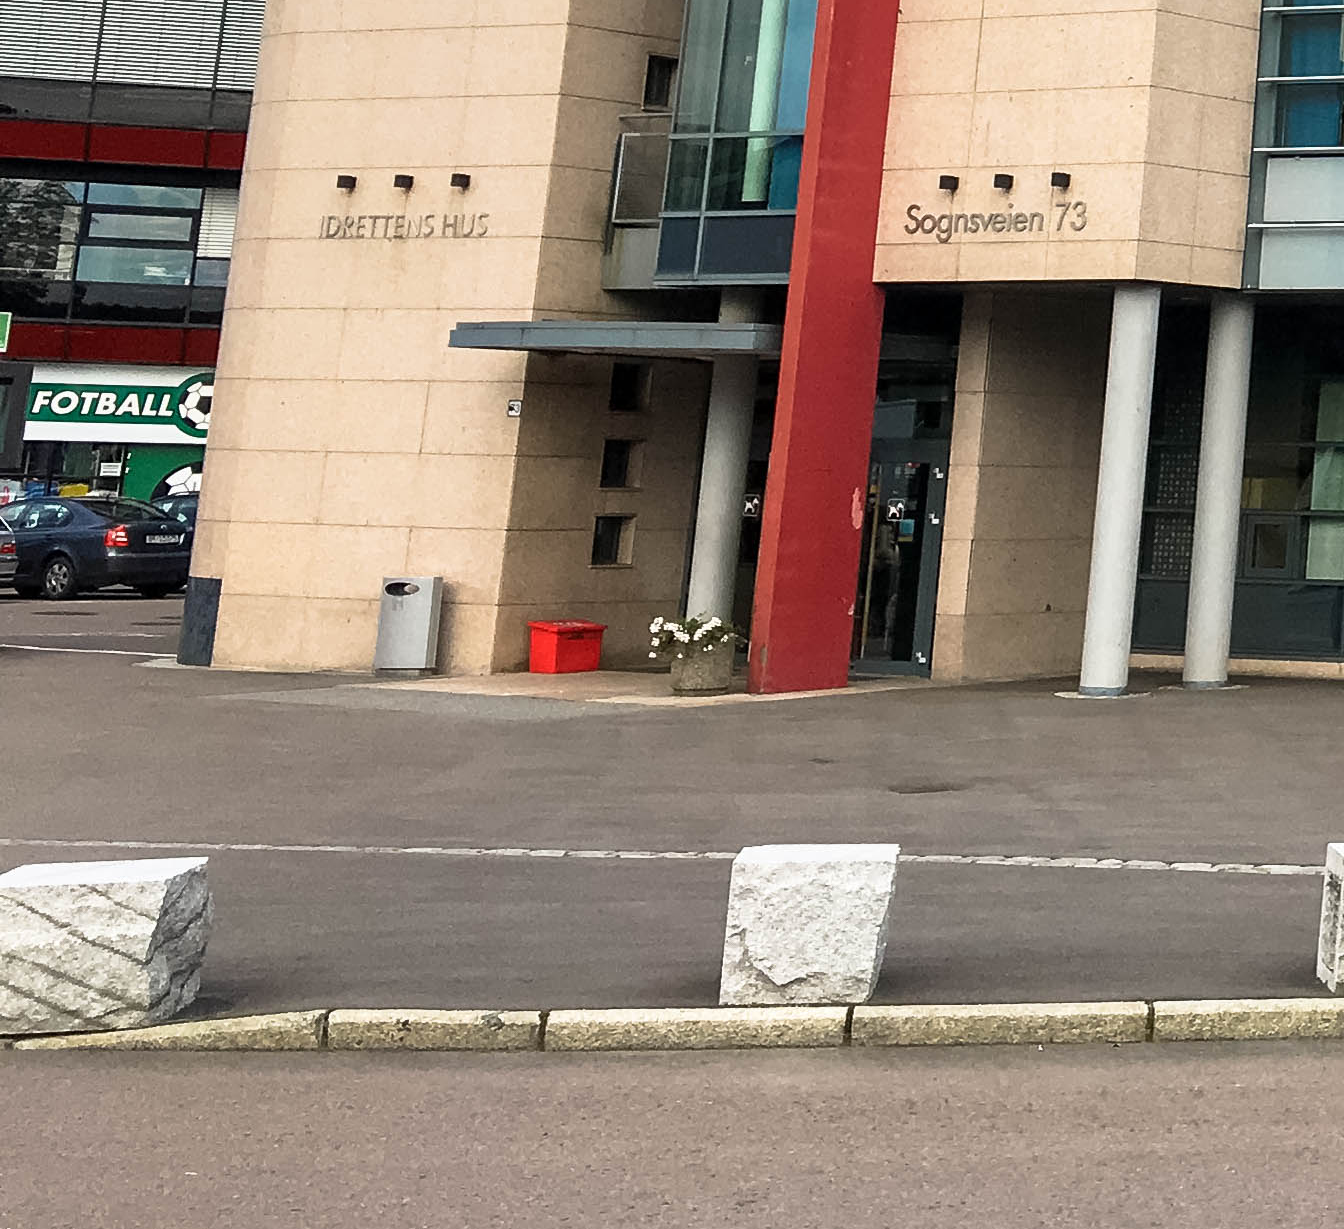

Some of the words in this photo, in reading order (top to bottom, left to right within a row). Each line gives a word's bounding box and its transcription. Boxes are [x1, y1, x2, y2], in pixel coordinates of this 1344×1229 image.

[319, 214, 435, 240] IDRETTENS
[442, 213, 490, 238] HUS
[904, 203, 1044, 243] Sognsveien
[1055, 201, 1088, 232] 73
[32, 390, 174, 417] FOTBALL
